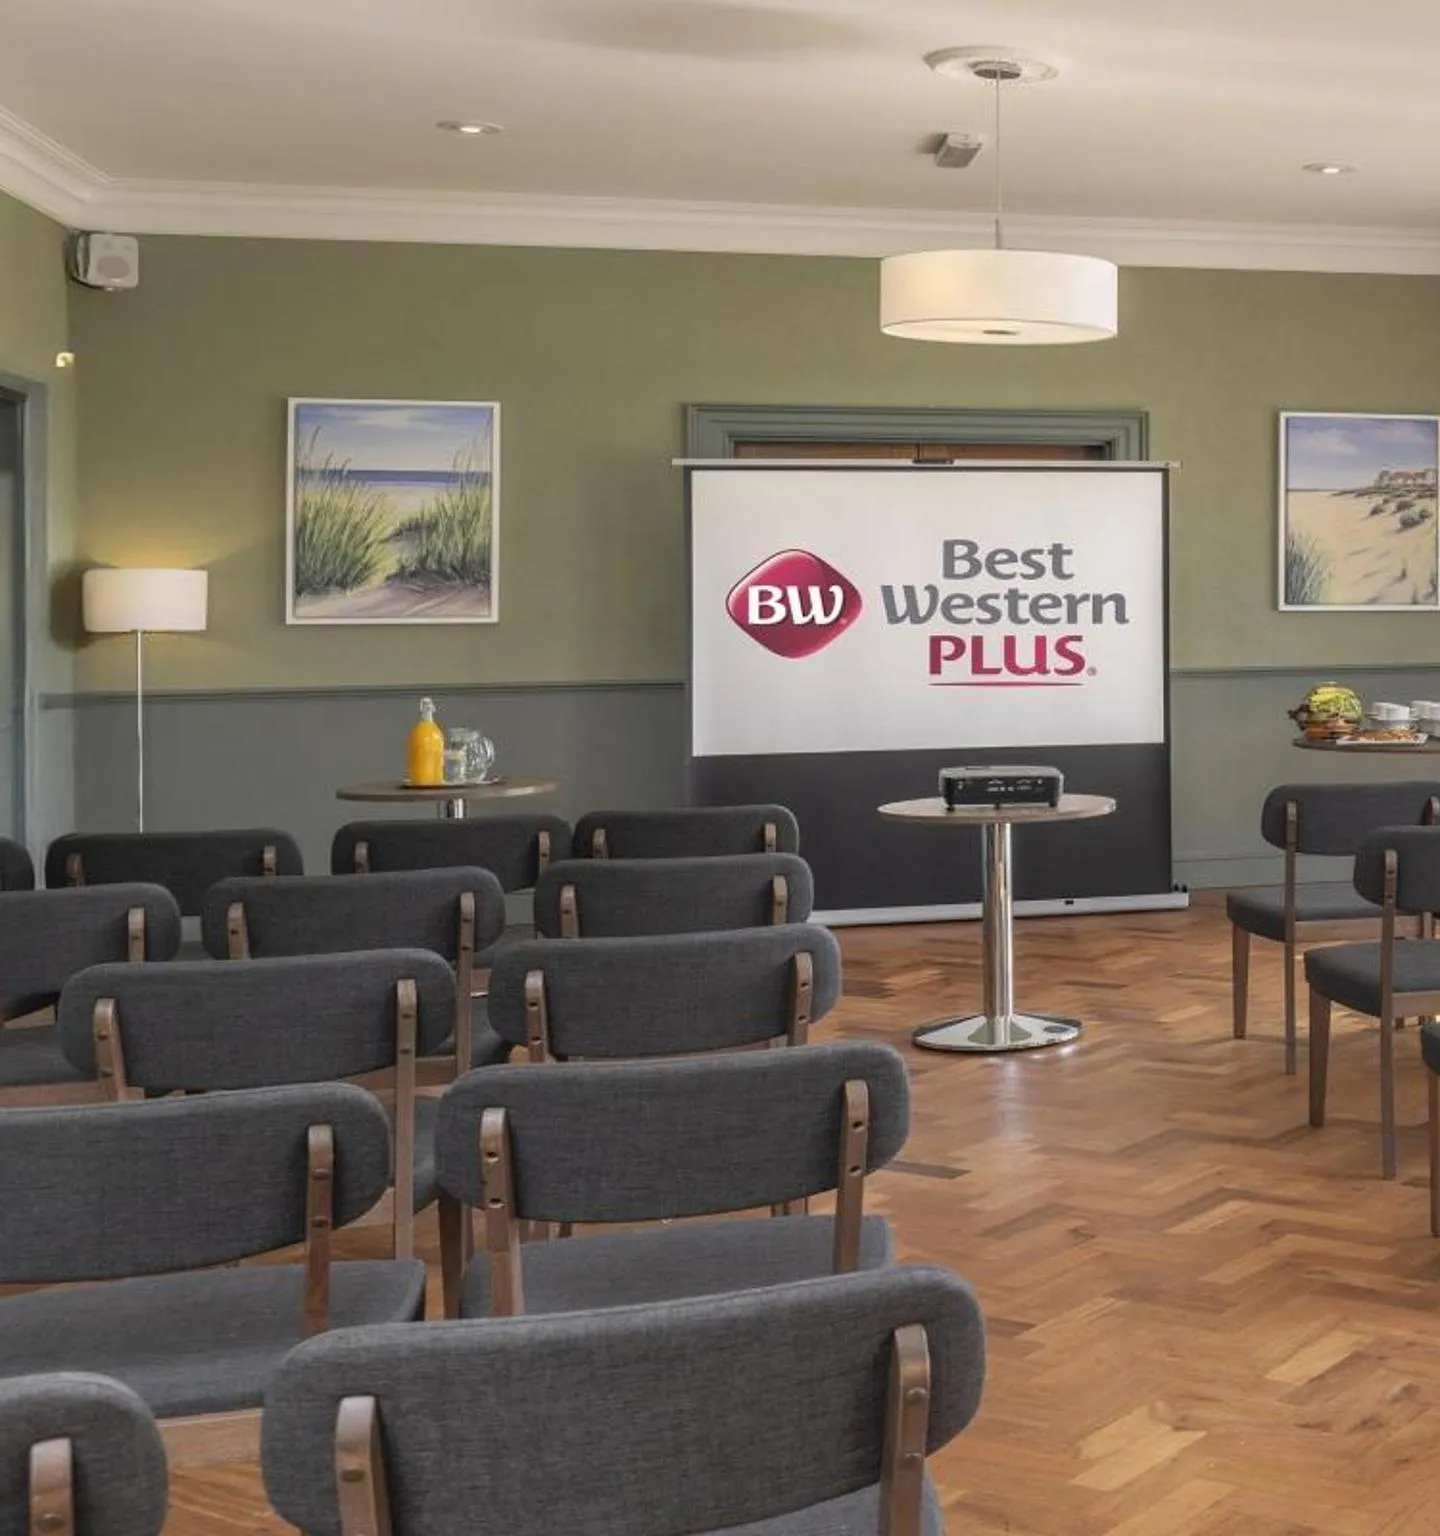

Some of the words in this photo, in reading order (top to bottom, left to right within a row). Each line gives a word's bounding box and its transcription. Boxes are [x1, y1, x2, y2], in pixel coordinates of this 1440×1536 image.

[943, 539, 1074, 581] Best
[747, 584, 843, 626] BW
[881, 584, 1129, 625] Western
[929, 635, 1086, 677] PLUS
